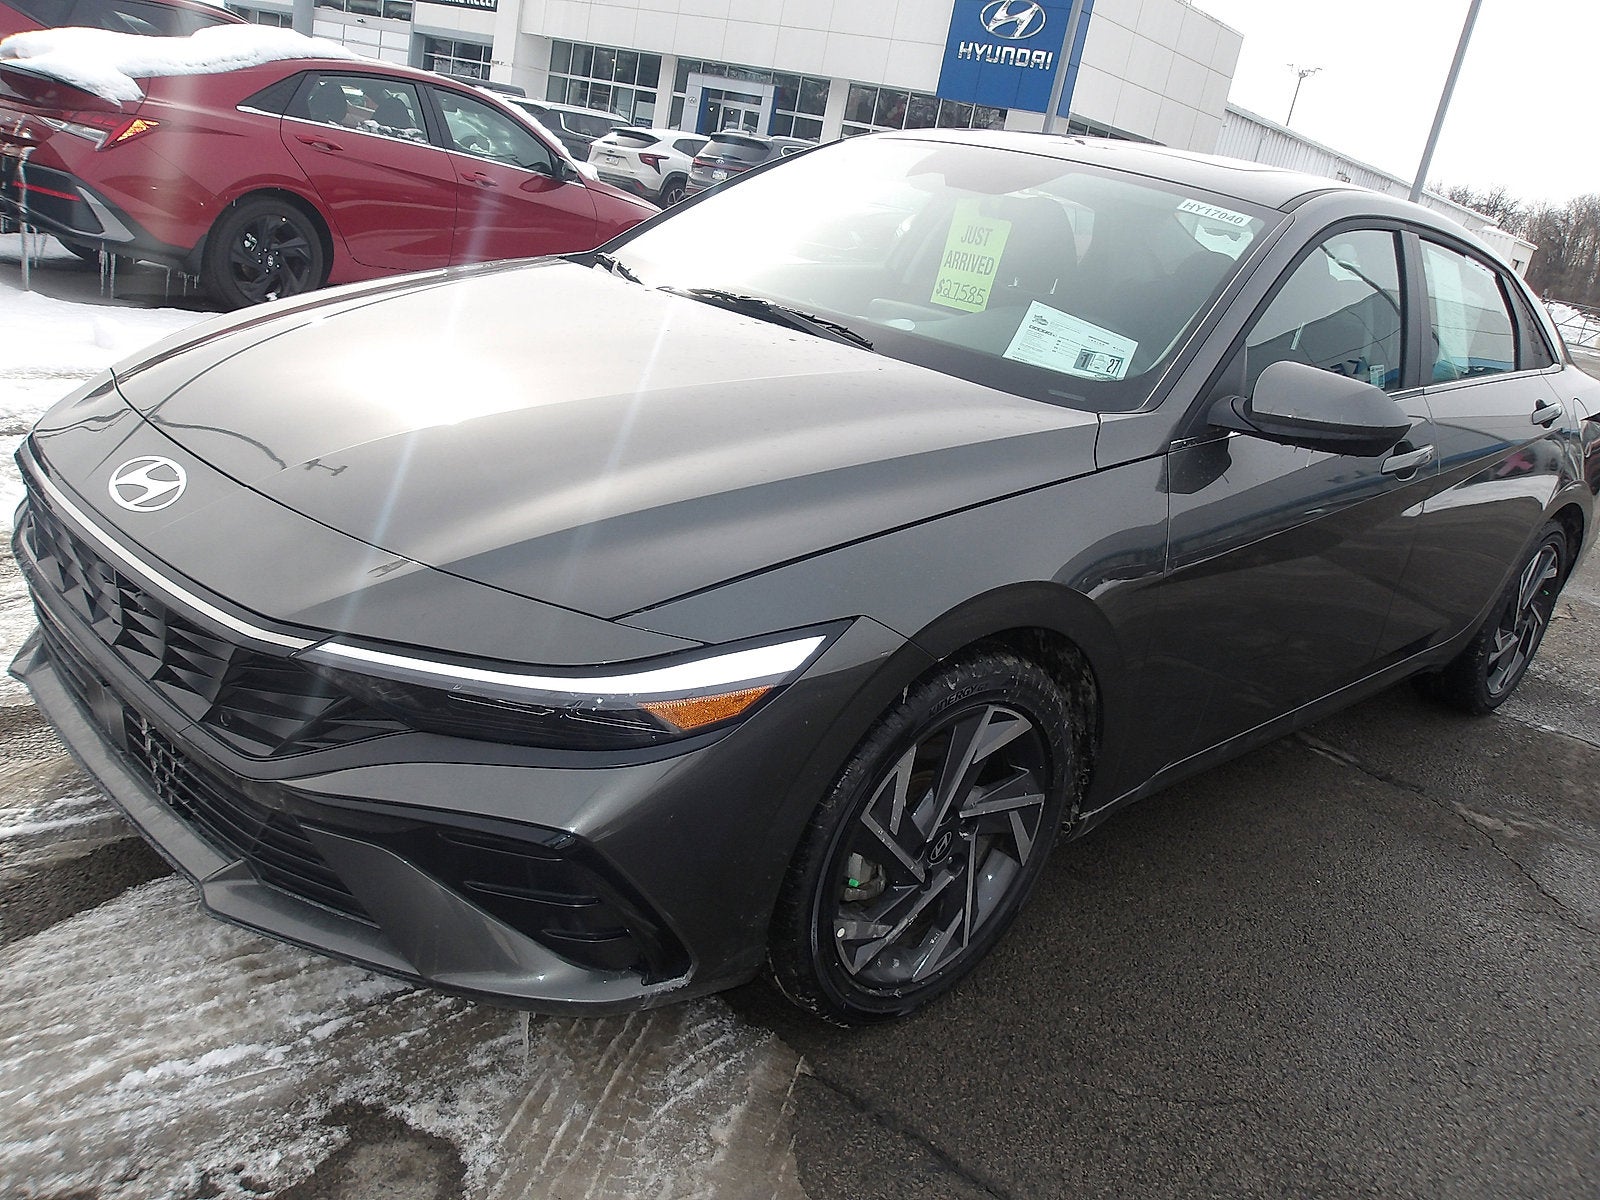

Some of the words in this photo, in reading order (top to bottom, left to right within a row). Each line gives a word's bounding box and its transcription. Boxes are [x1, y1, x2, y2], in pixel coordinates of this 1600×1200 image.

[957, 41, 1053, 70] HYUNDAI
[1183, 202, 1244, 224] HY17040
[961, 225, 993, 246] JUST
[944, 250, 995, 275] ARRIVED
[1106, 358, 1120, 374] 27
